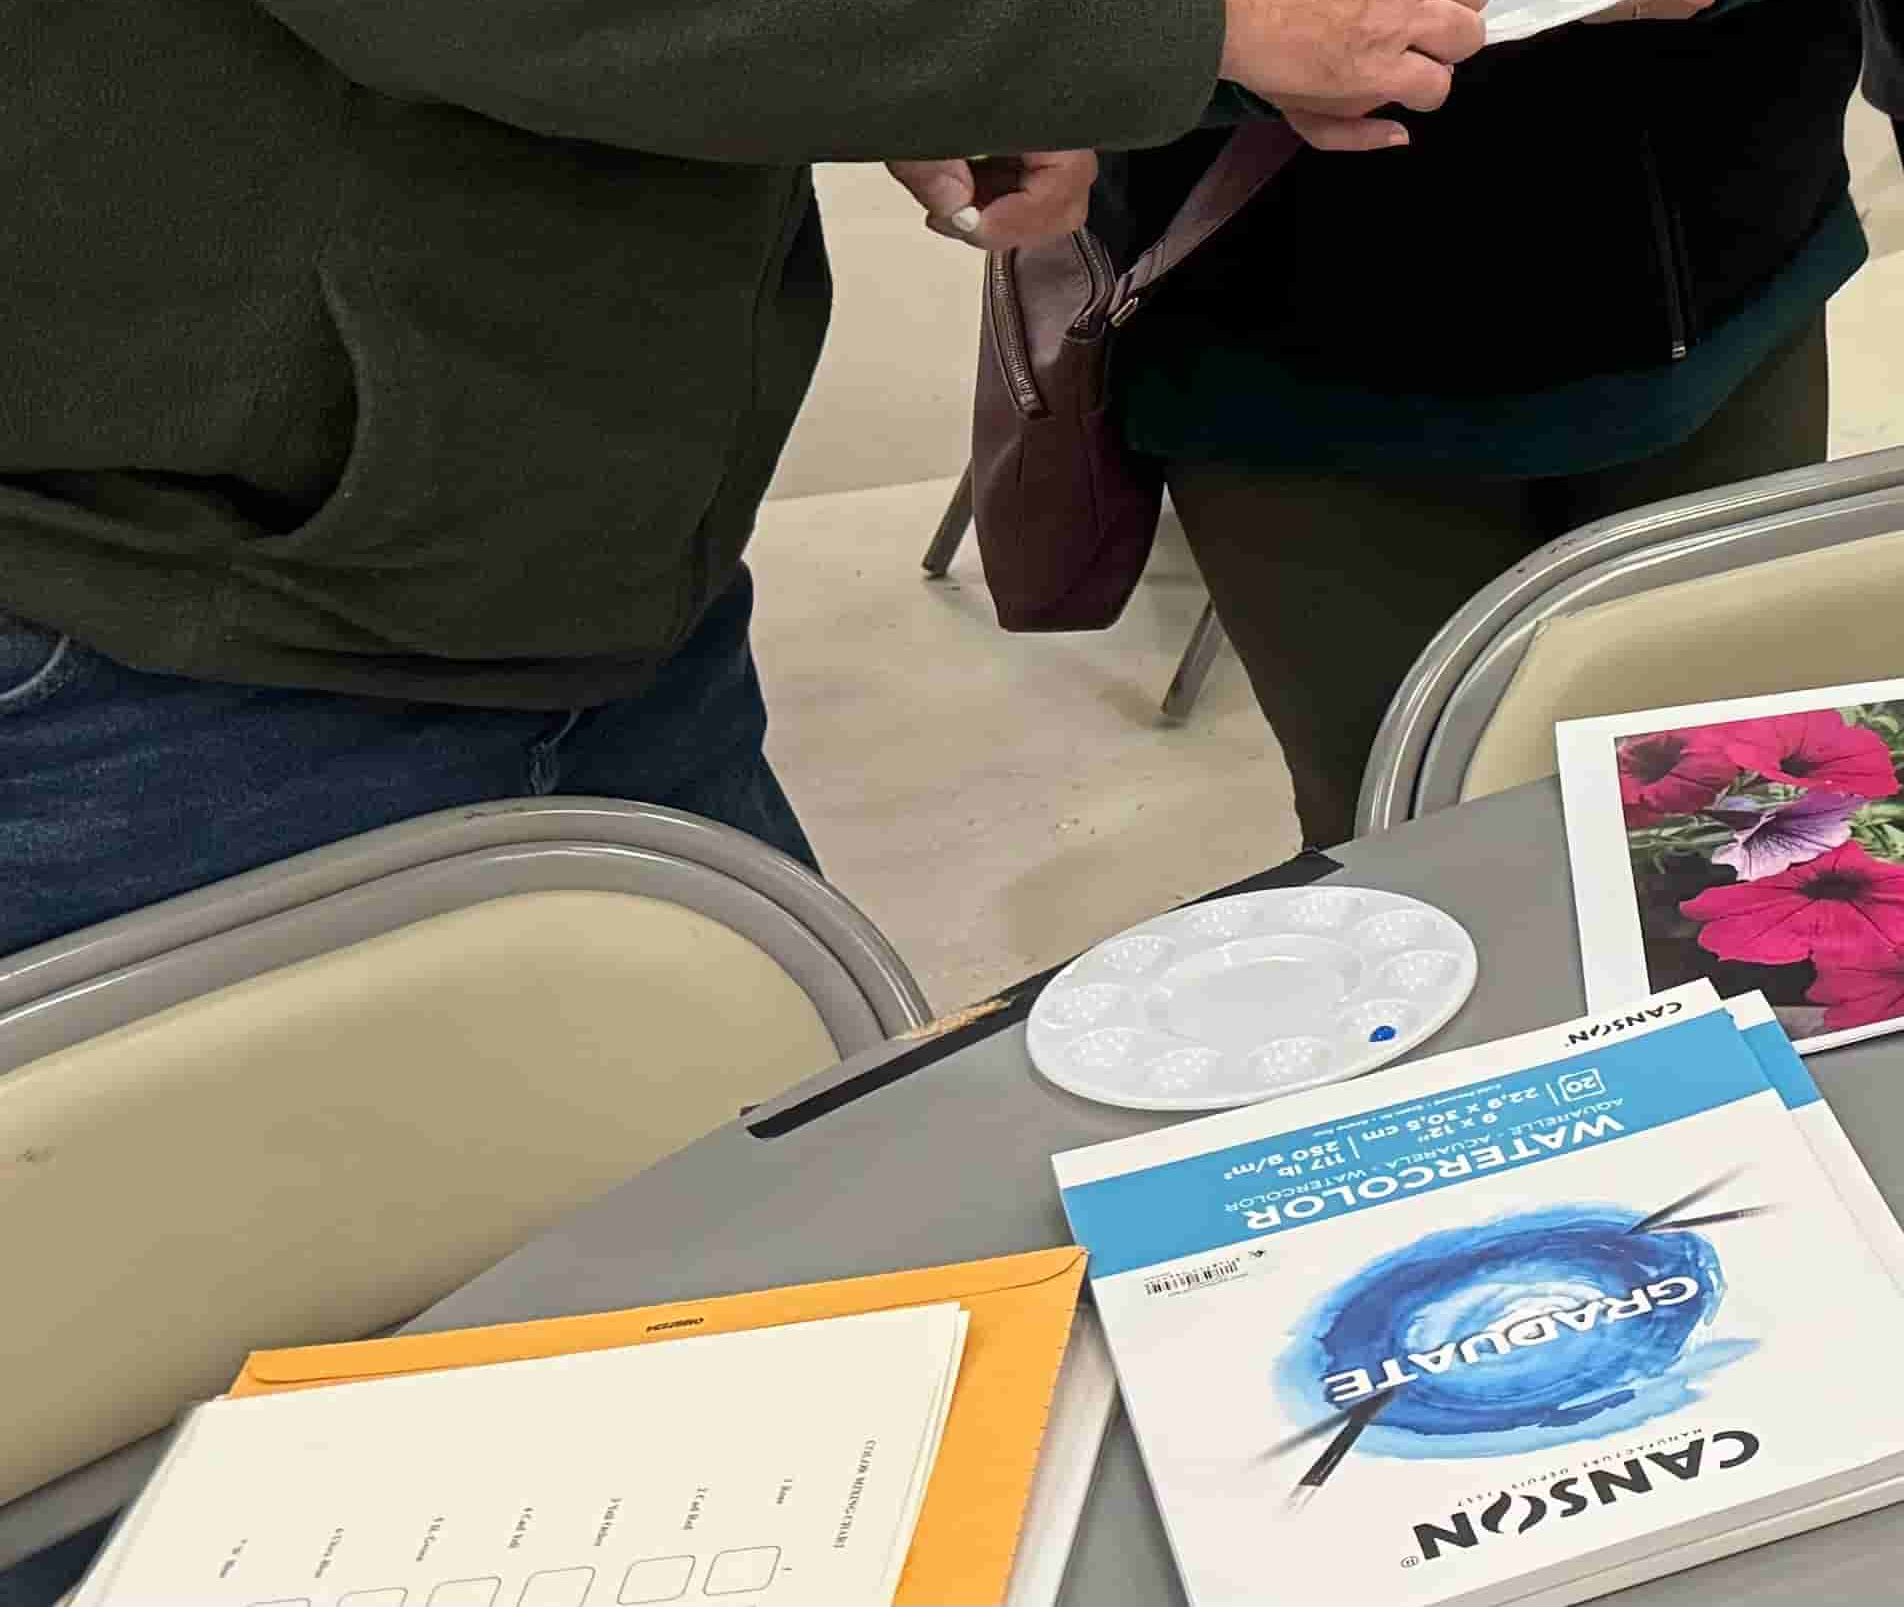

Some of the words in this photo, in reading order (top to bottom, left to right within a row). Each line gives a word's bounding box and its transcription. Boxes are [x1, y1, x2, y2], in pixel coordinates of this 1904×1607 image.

[1567, 1000, 1683, 1045] CANSON
[1565, 1077, 1597, 1093] 20
[1362, 1125, 1399, 1141] cm
[1292, 1140, 1340, 1161] 250
[1312, 1154, 1345, 1171] 117
[1246, 1113, 1625, 1229] WATERCOLOR
[1277, 1163, 1302, 1178] lb
[1223, 1168, 1367, 1212] WATERCOLOR
[1323, 1276, 1700, 1402] GRADUATE
[1412, 1430, 1760, 1561] CANSON
